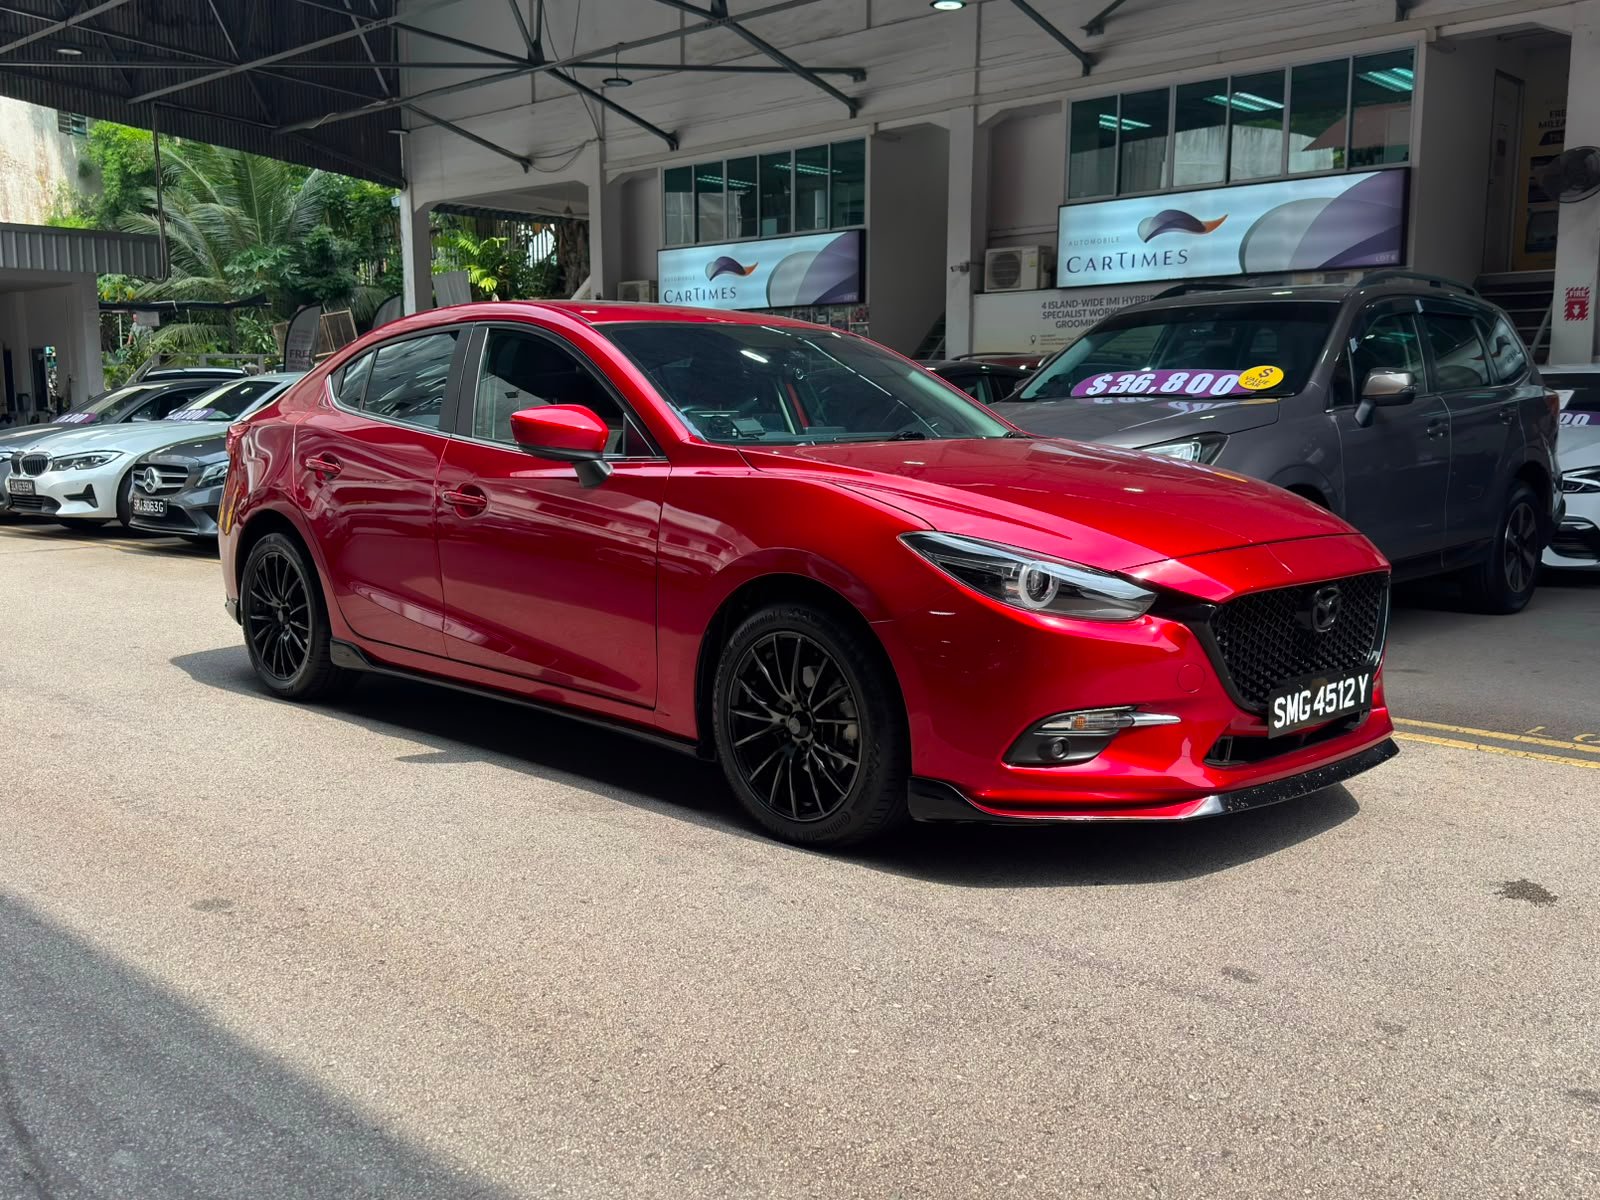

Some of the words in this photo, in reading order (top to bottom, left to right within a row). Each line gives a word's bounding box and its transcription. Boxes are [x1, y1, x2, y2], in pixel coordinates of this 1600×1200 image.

[1068, 236, 1120, 247] AUTOMOBILE
[1066, 248, 1189, 274] CARTIMES
[663, 286, 737, 304] CARTIMES
[1041, 302, 1047, 310] 4
[1048, 298, 1105, 310] ISLAND-WIDE
[1106, 297, 1120, 306] IMI
[1042, 309, 1087, 320] SPECIALIST
[1088, 307, 1120, 317] WORK
[1055, 318, 1101, 329] GROOMIN
[1085, 371, 1239, 396] $36,800
[1244, 380, 1261, 388] CAR
[1245, 375, 1270, 385] VALUE
[1273, 689, 1312, 729] SMG
[1313, 677, 1356, 716] 4512
[1358, 673, 1369, 704] Y
